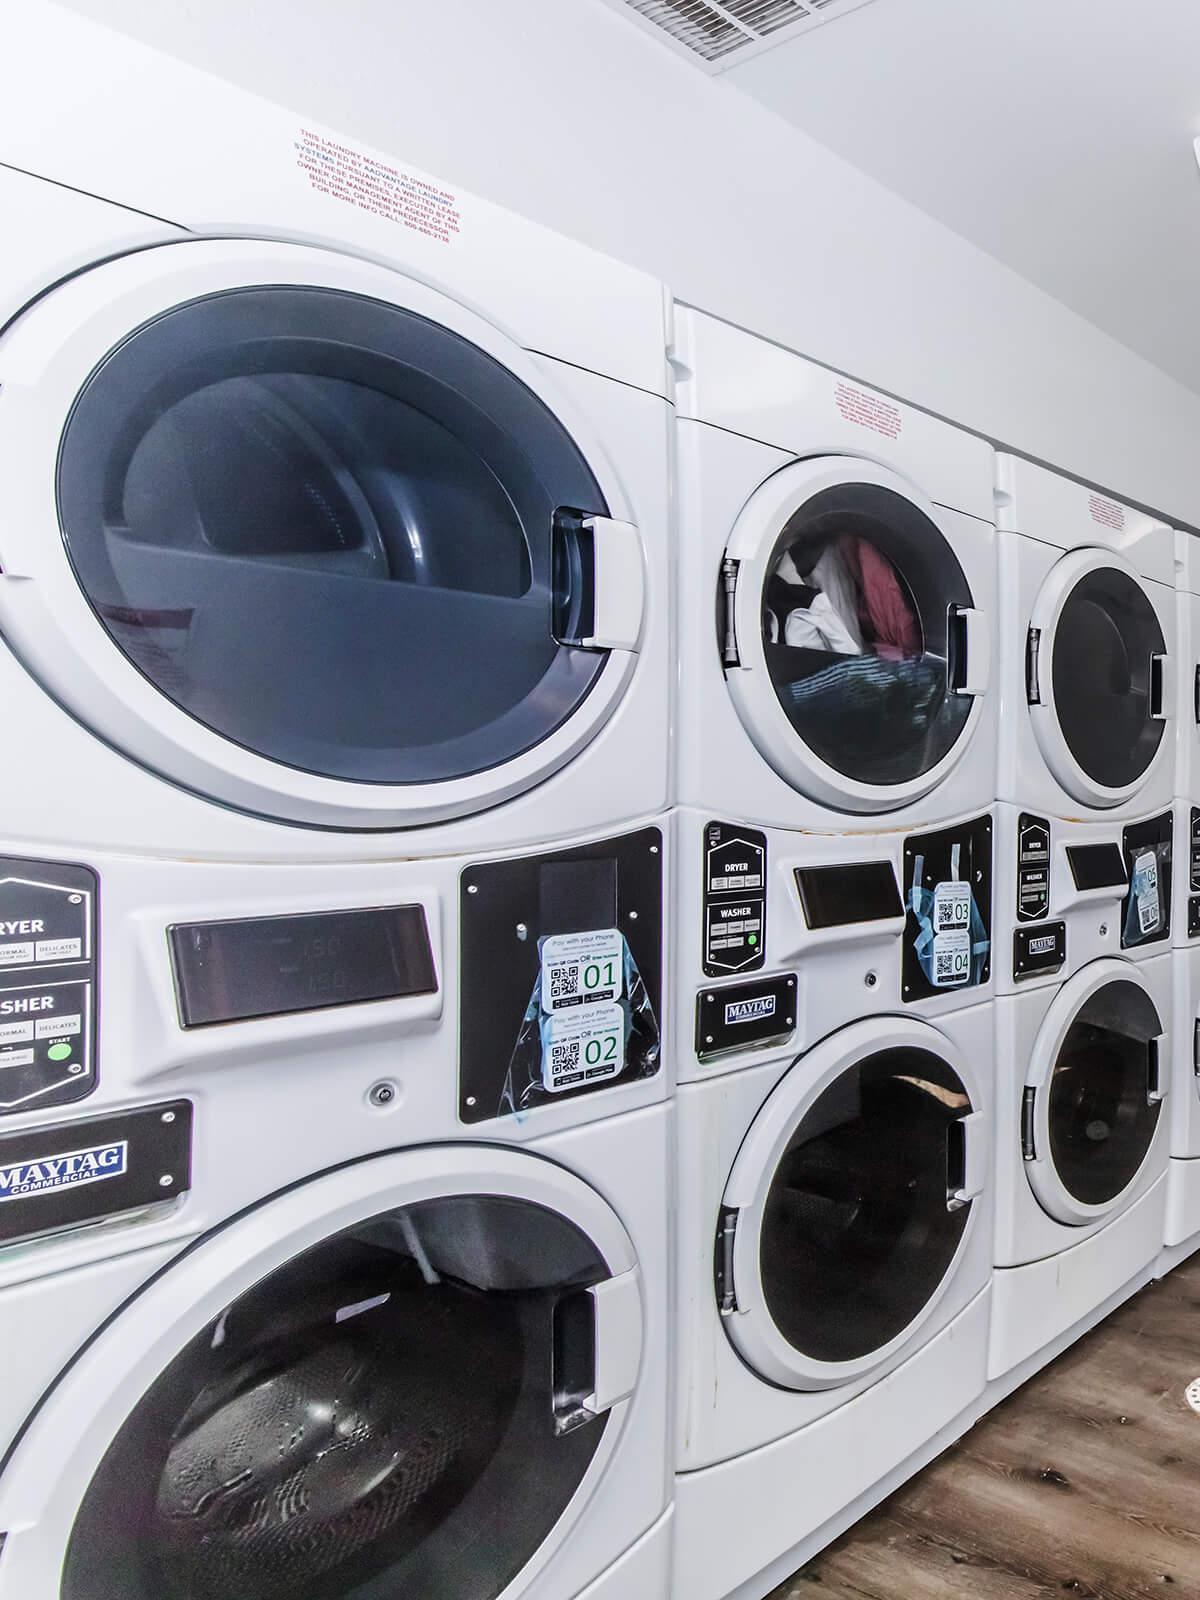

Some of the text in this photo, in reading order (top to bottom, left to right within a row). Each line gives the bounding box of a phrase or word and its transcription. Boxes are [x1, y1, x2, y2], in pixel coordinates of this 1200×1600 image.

[300, 129, 319, 142] THIS
[322, 139, 360, 160] LAUNDRY
[363, 157, 398, 176] MACHINE
[410, 174, 438, 194] OWNED
[440, 190, 454, 202] AND
[303, 139, 349, 162] OPERATED
[351, 159, 362, 168] BY
[418, 189, 453, 207] LAUNDRY
[294, 142, 334, 164] SYSTEMS
[337, 162, 380, 184] PURSUANT
[383, 181, 393, 190] TO
[403, 189, 435, 207] WRITTEN
[438, 204, 460, 219] LEASE
[299, 153, 317, 165] FOR
[320, 162, 347, 177] THESE
[394, 194, 434, 215] EXECUTED
[436, 210, 446, 219] BY
[448, 215, 457, 224] AN
[297, 161, 460, 233] OWNER OR MANAGEMENT AGENT OF THIS
[312, 183, 329, 194] FOR
[332, 191, 356, 206] MORE
[358, 202, 378, 213] INFO
[353, 192, 365, 202] OR
[368, 197, 391, 212] THEIR
[724, 862, 748, 872] DRYER
[720, 907, 752, 918] WASHER
[956, 904, 968, 920] 03
[955, 954, 968, 971] 04
[584, 962, 616, 989] 01
[0, 996, 54, 1014] SHER
[728, 998, 772, 1017] MAYTAG
[40, 1022, 77, 1032] DELICATES
[48, 1036, 70, 1044] START
[585, 1036, 617, 1064] 02
[0, 1148, 120, 1189] MAYTAG
[11, 1169, 99, 1194] COMMERCIAL
